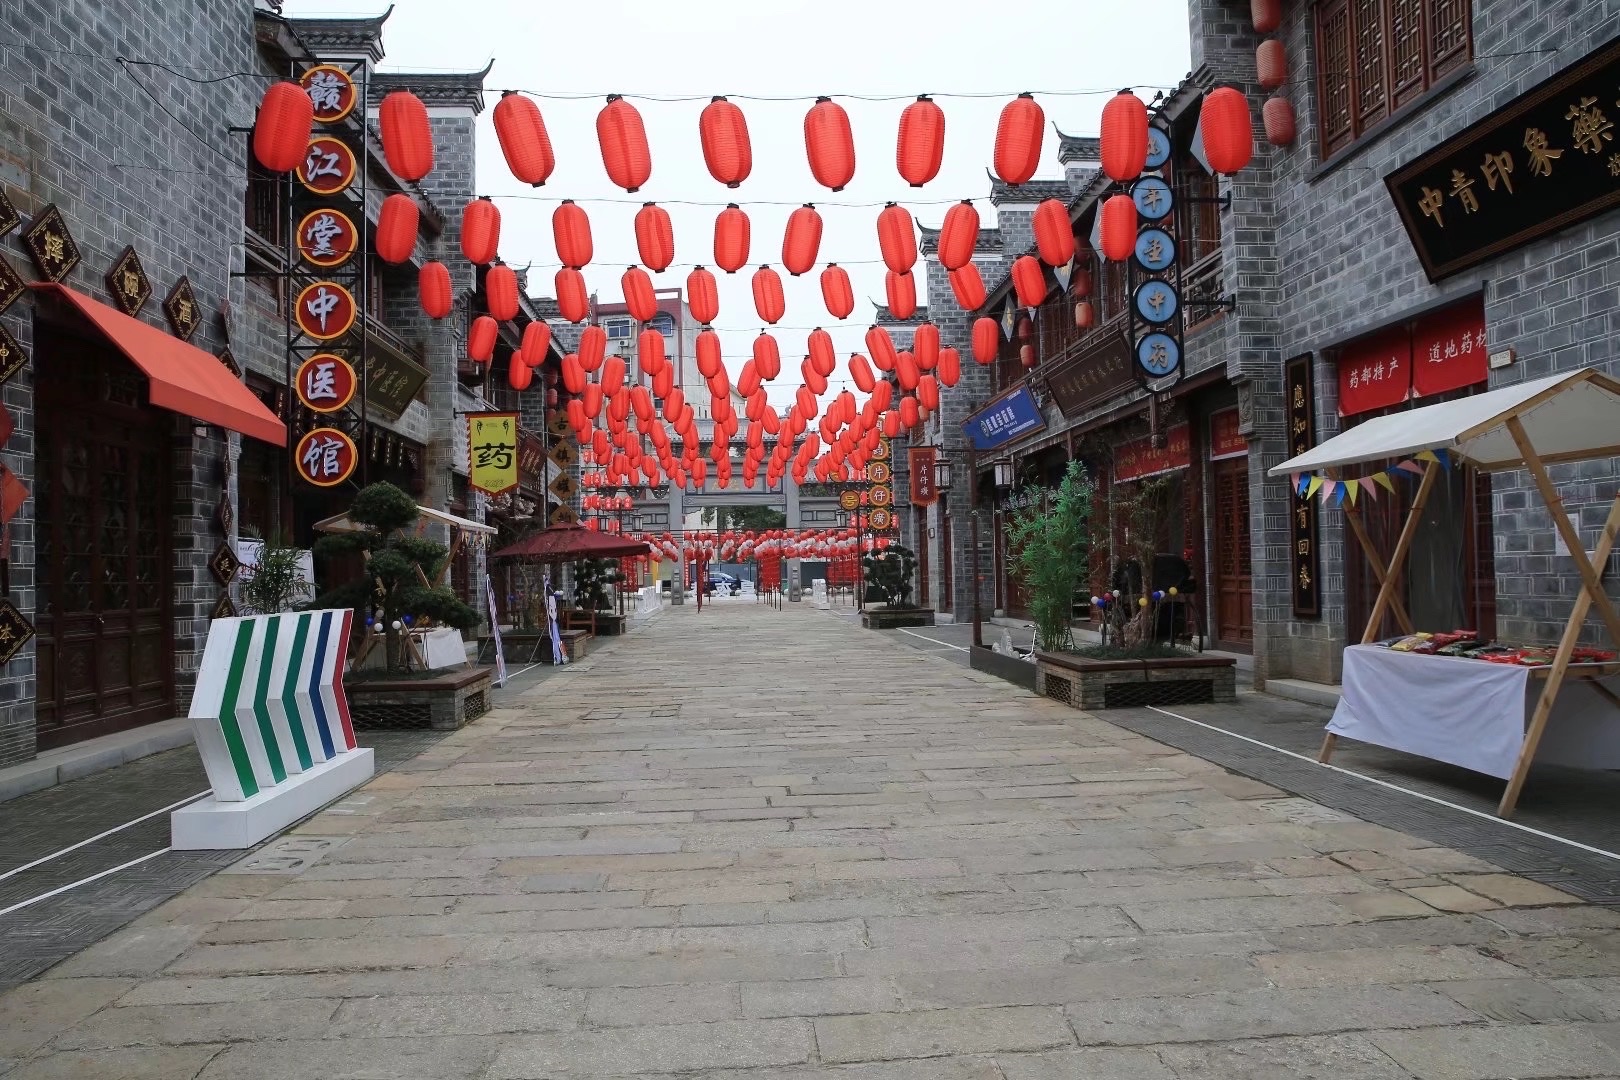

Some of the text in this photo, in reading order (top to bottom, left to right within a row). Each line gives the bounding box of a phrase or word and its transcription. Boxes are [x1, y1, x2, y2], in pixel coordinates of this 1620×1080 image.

[1417, 95, 1620, 229] 中青印象藥
[303, 71, 346, 478] 赣江堂中医馆
[1428, 328, 1487, 363] 道地药材
[1348, 356, 1399, 389] 药都特产
[473, 442, 516, 470] 药
